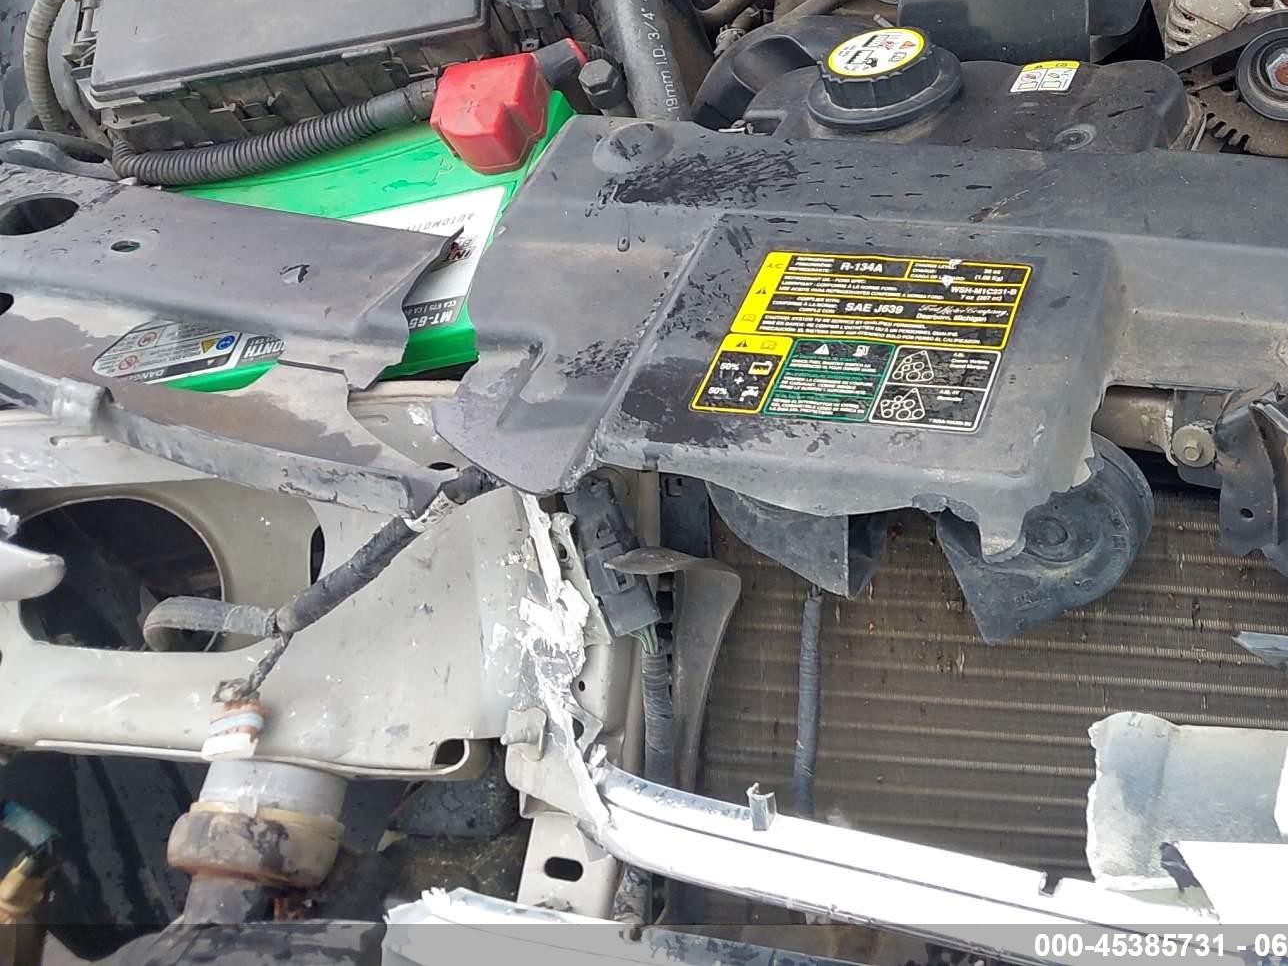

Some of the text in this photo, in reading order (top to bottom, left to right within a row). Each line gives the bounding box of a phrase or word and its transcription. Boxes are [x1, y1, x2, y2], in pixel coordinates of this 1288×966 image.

[652, 44, 668, 65] I.D.
[662, 69, 680, 113] 19mm
[840, 261, 883, 273] R-134A
[844, 302, 904, 315] SAE J639
[408, 309, 453, 329] MT-65
[719, 362, 740, 371] 50%
[707, 386, 728, 395] 50%
